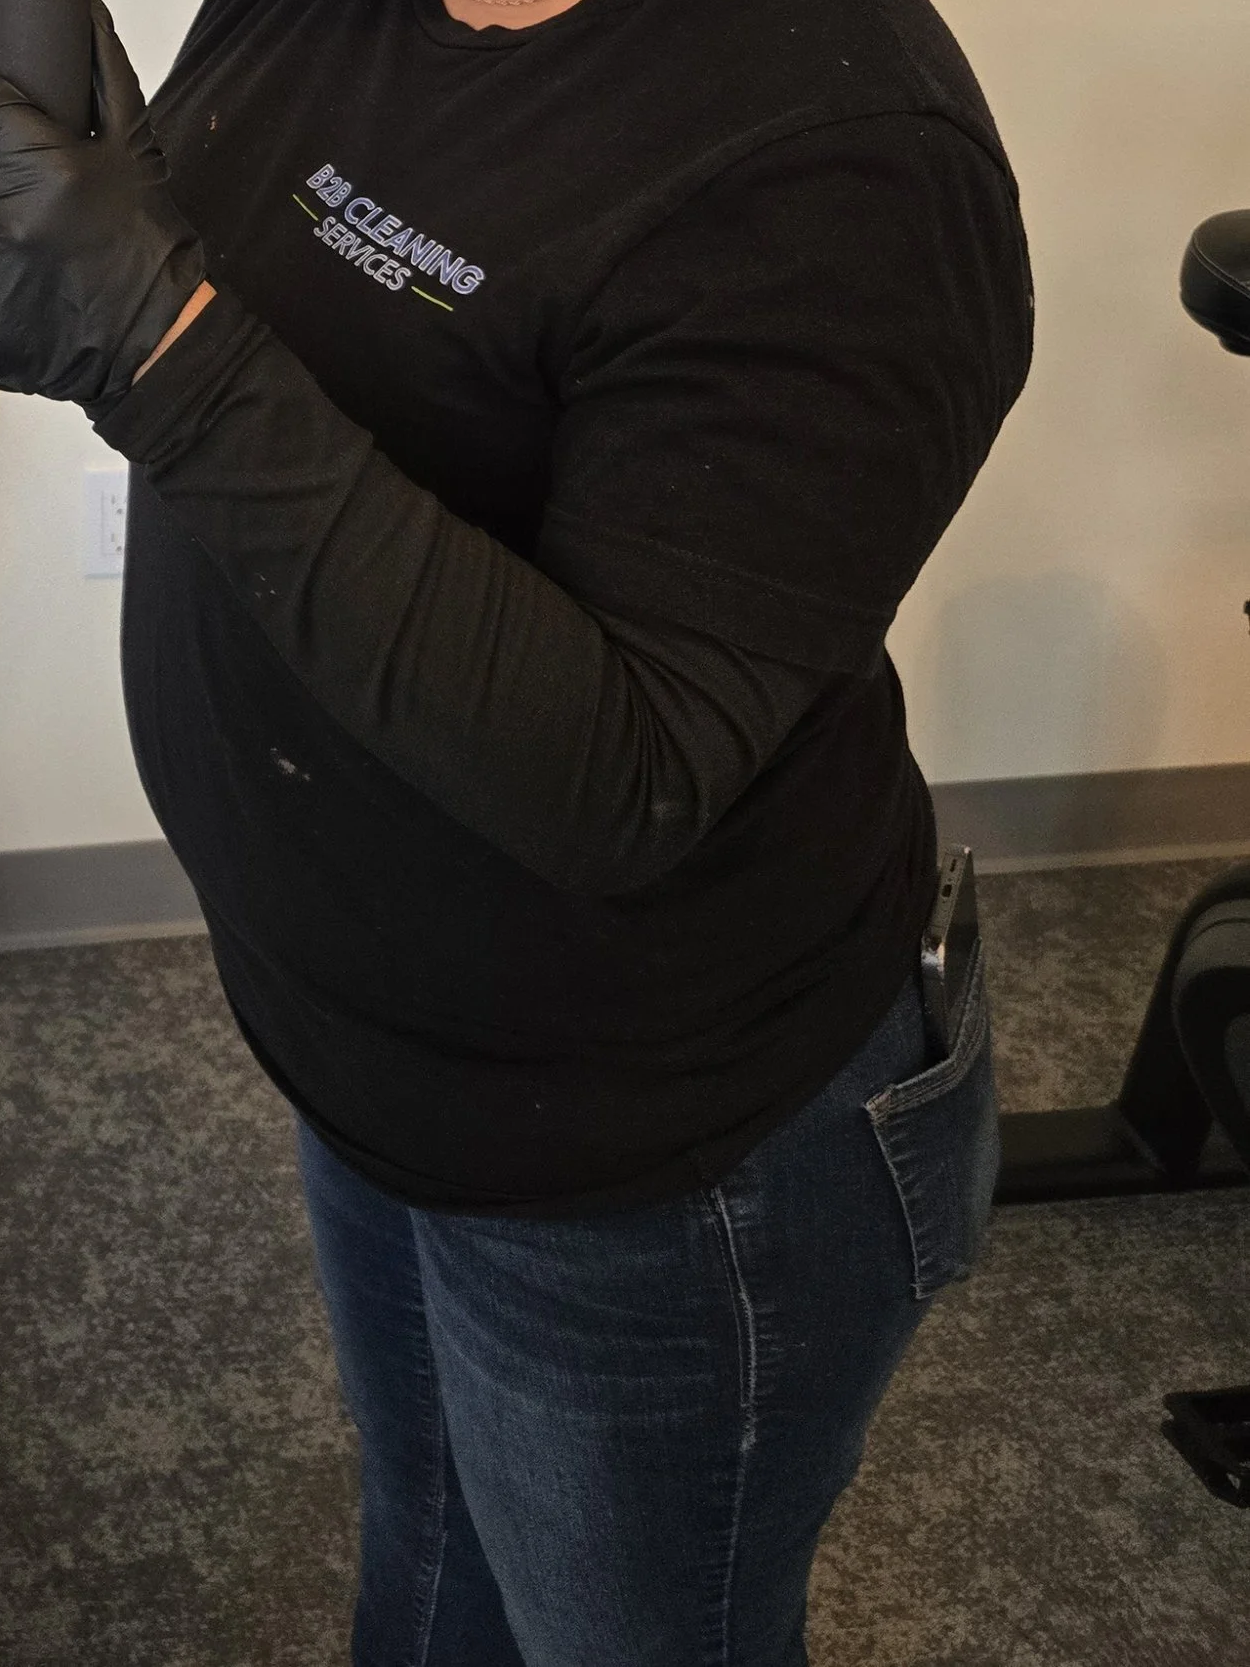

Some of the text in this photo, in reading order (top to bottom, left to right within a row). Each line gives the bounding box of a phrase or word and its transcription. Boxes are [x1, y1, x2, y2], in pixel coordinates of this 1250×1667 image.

[306, 164, 485, 295] B2B CLEANING
[313, 216, 412, 291] SERVICES
